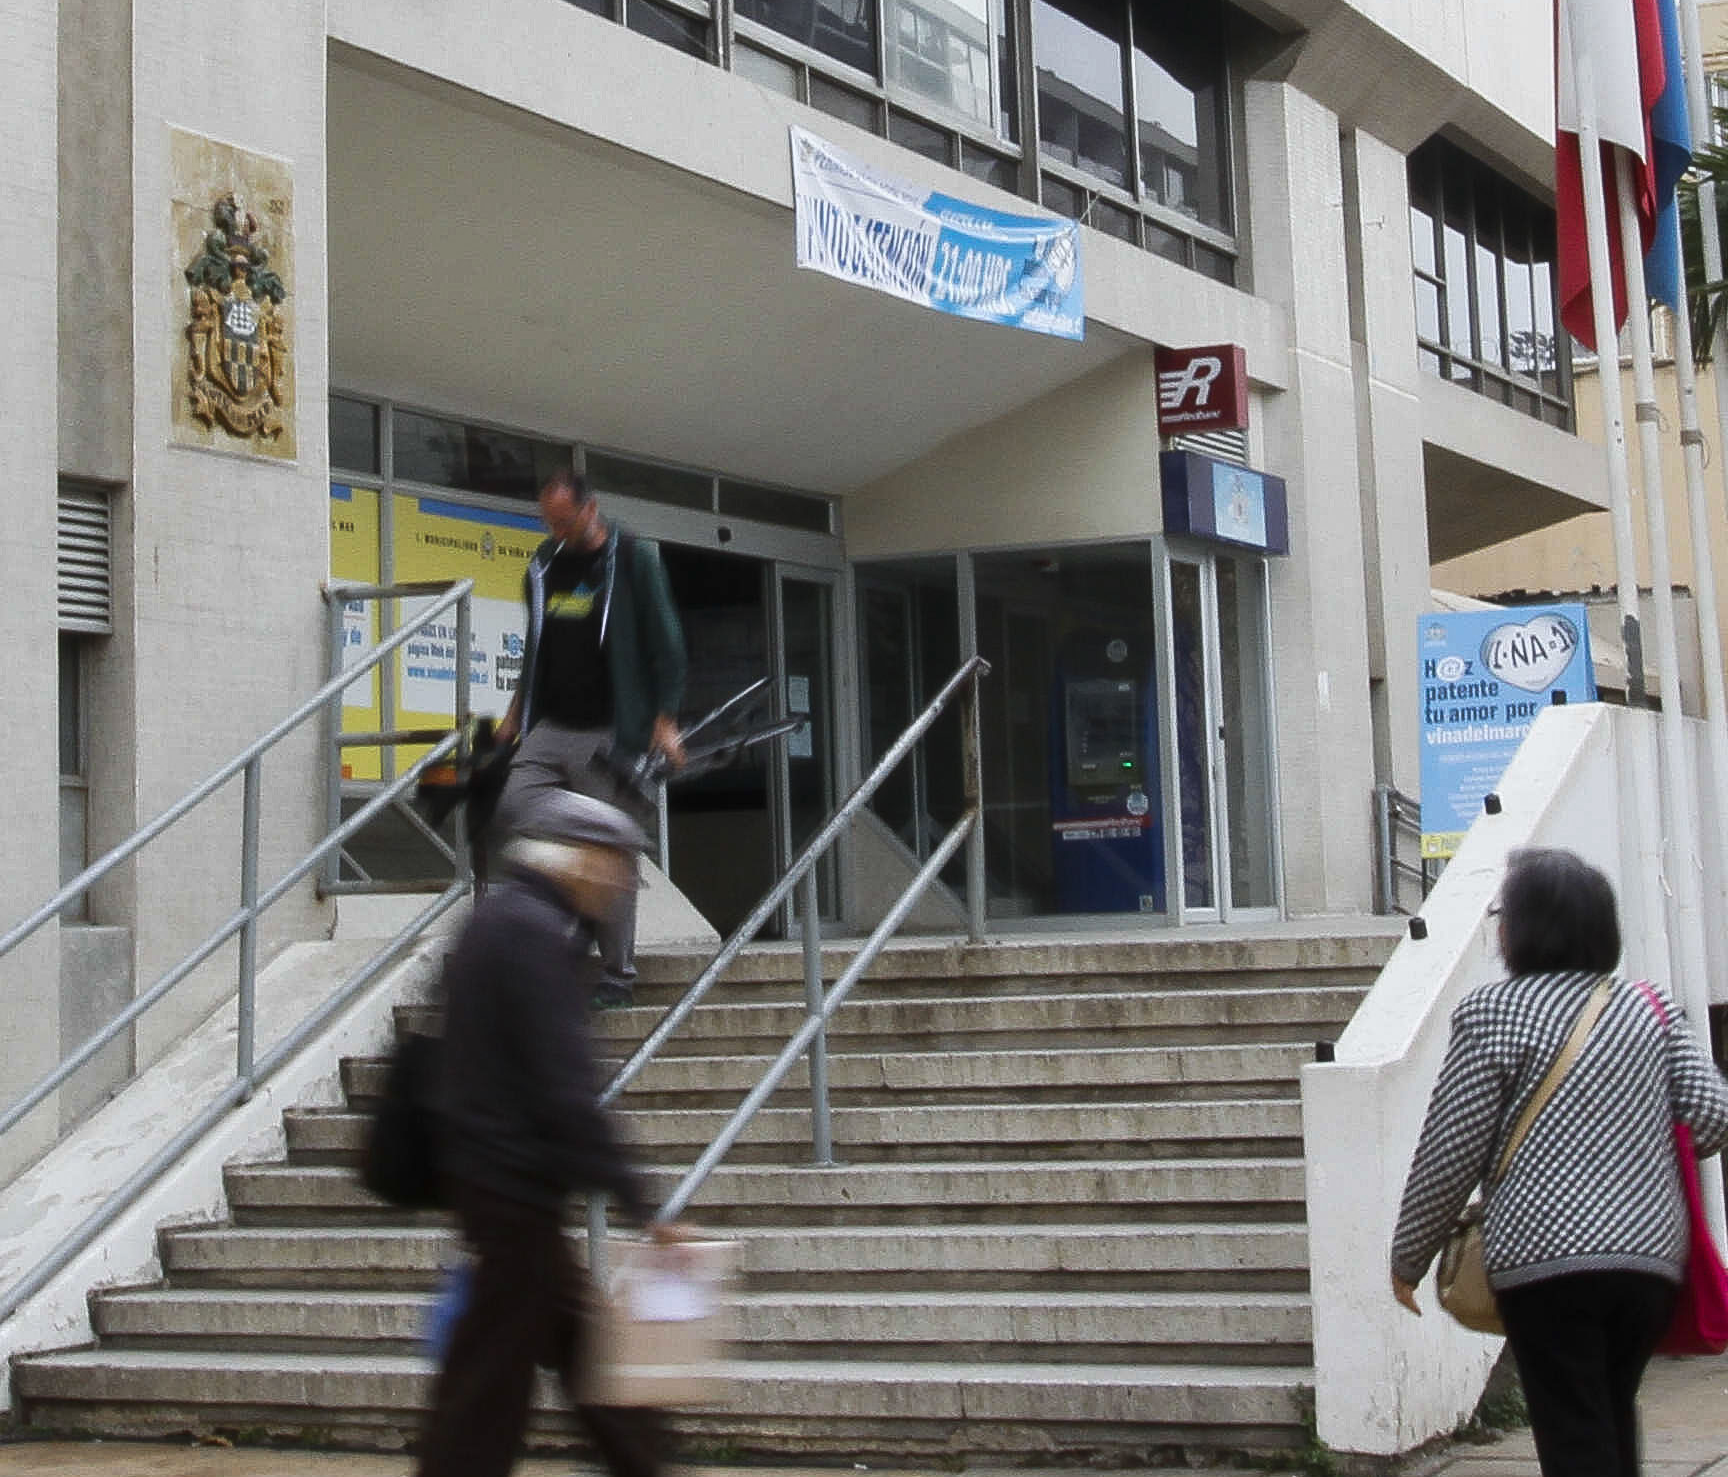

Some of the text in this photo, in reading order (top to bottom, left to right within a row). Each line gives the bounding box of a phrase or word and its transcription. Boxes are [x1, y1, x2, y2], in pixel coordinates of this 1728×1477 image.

[1424, 679, 1500, 705] patente
[1424, 700, 1538, 724] tu amor por
